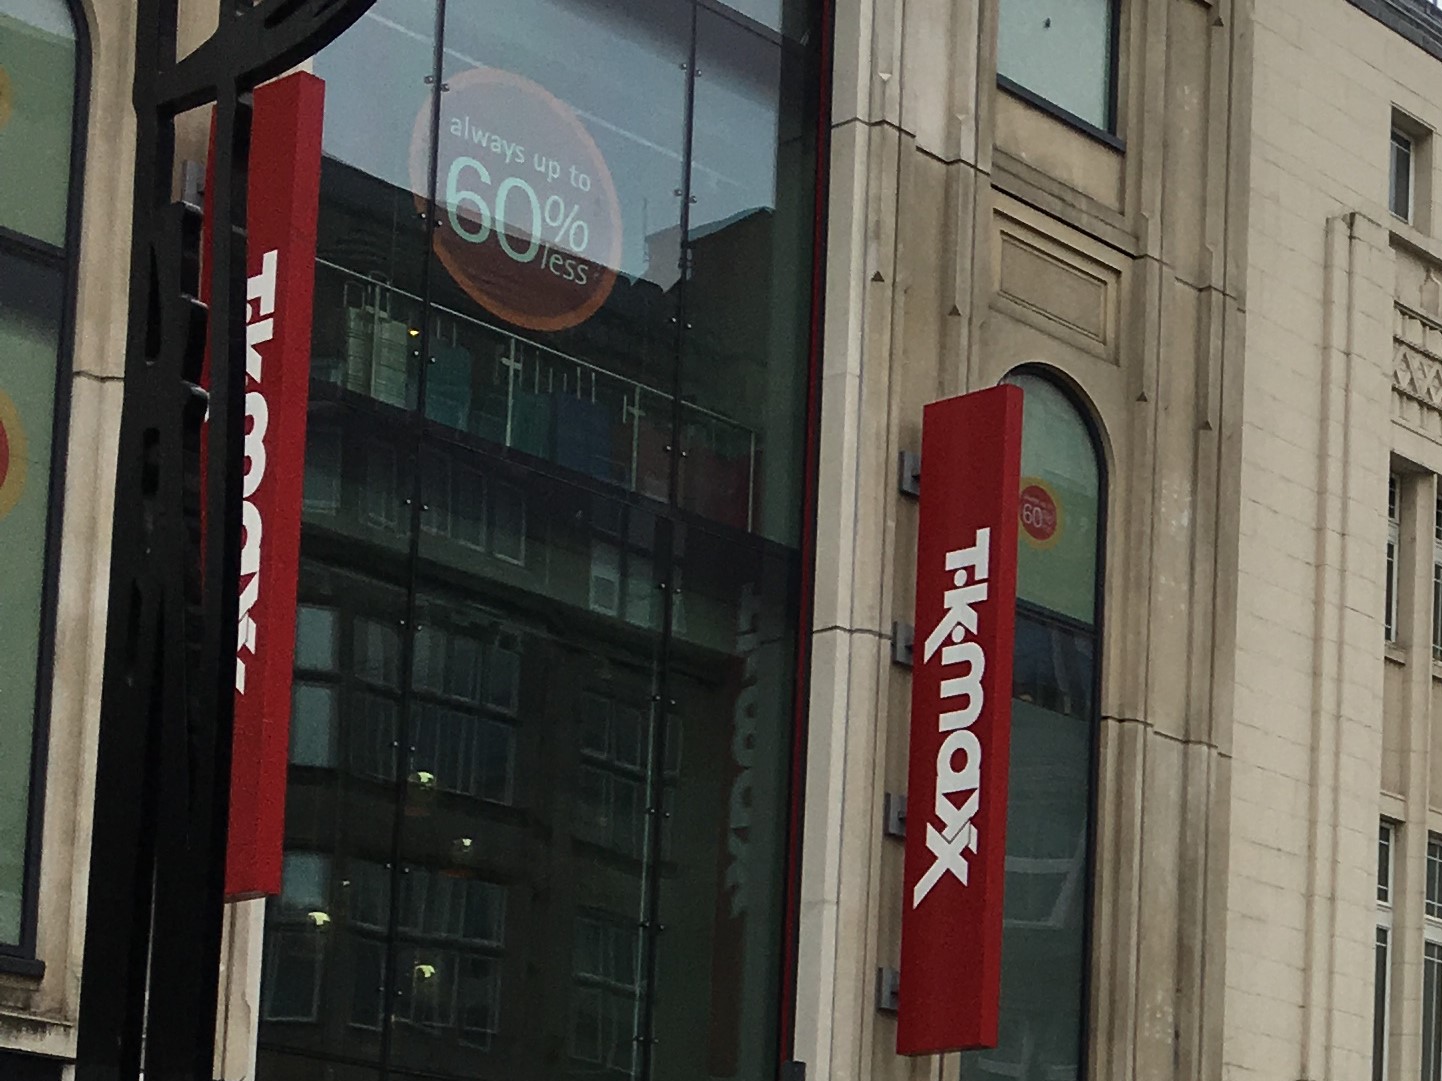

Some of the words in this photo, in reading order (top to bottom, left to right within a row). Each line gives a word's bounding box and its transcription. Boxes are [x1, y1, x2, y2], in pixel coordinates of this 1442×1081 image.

[450, 116, 525, 164] always
[534, 153, 561, 182] up
[569, 164, 591, 192] to
[446, 156, 588, 262] 60%
[541, 242, 588, 285] less
